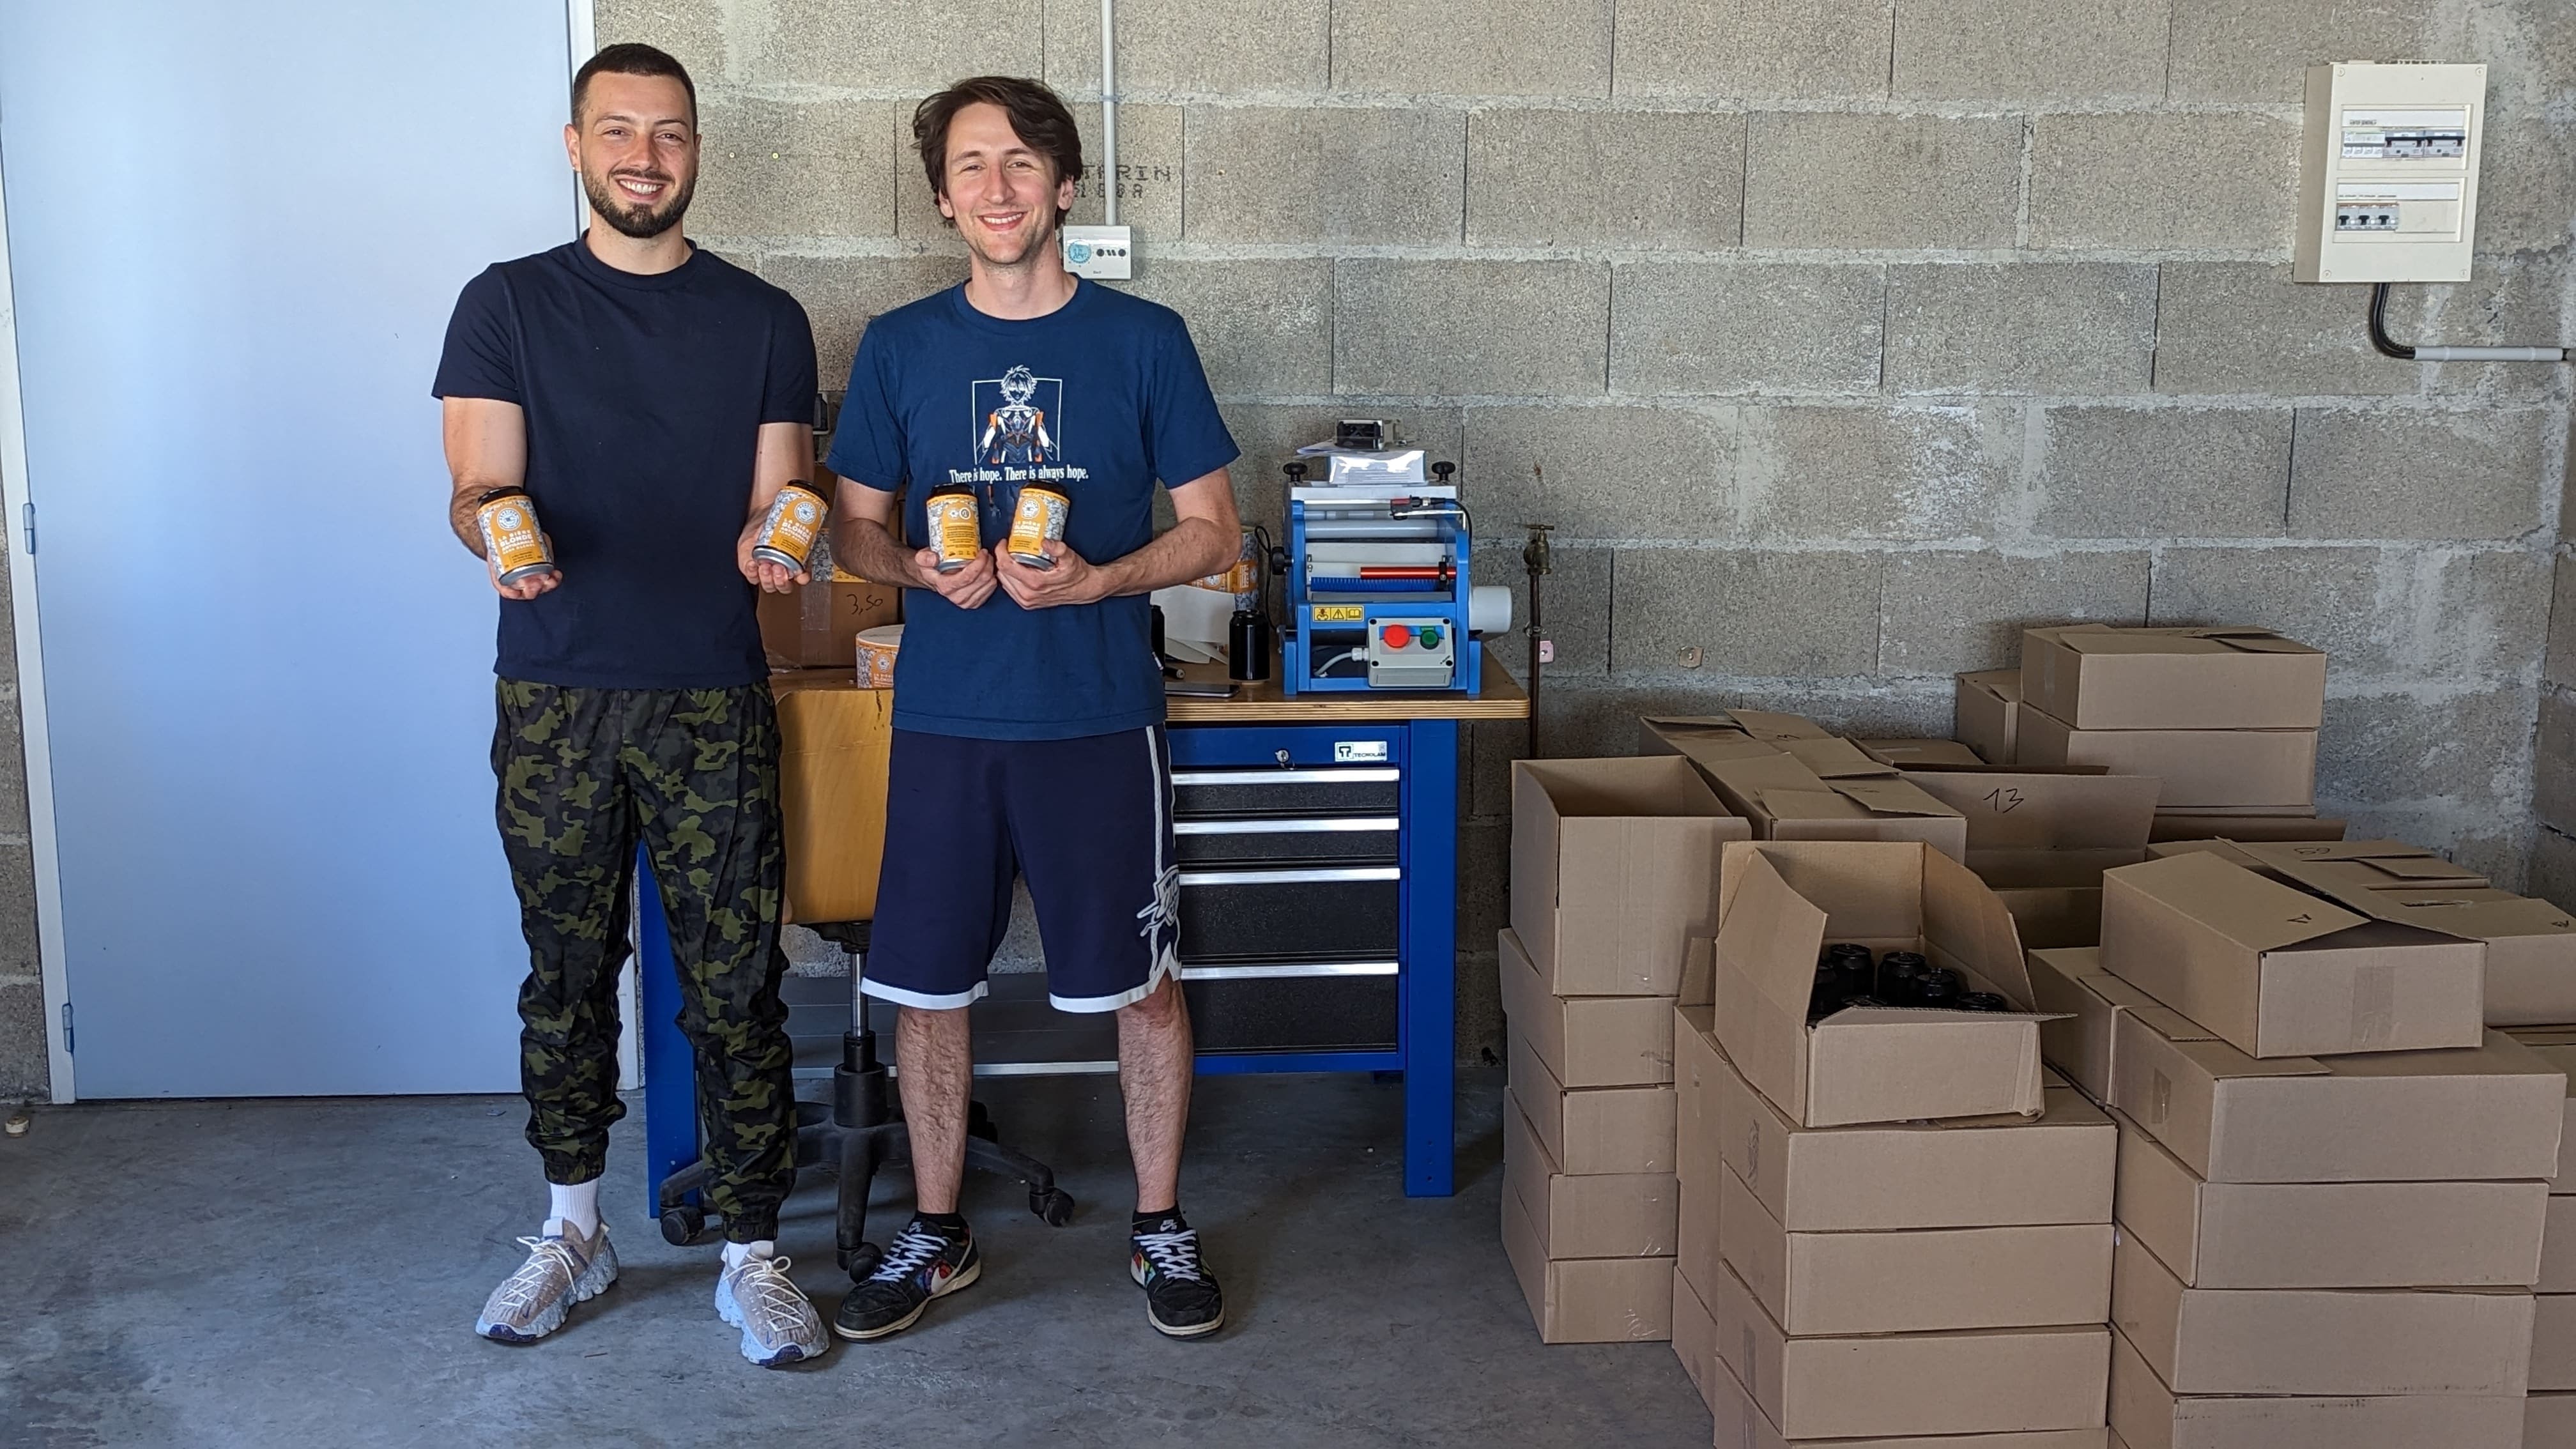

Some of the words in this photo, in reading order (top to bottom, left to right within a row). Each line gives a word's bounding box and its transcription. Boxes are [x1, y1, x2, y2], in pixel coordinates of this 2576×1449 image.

[949, 470, 972, 484] There
[973, 470, 979, 482] is
[979, 468, 1002, 483] hope.
[1004, 466, 1026, 481] There
[1029, 464, 1036, 480] is
[1038, 465, 1064, 482] always
[1067, 463, 1089, 480] hope.
[500, 533, 533, 546] BLONDE
[782, 523, 811, 541] BLONDE
[847, 594, 883, 615] 3,50
[1983, 788, 2024, 813] 13
